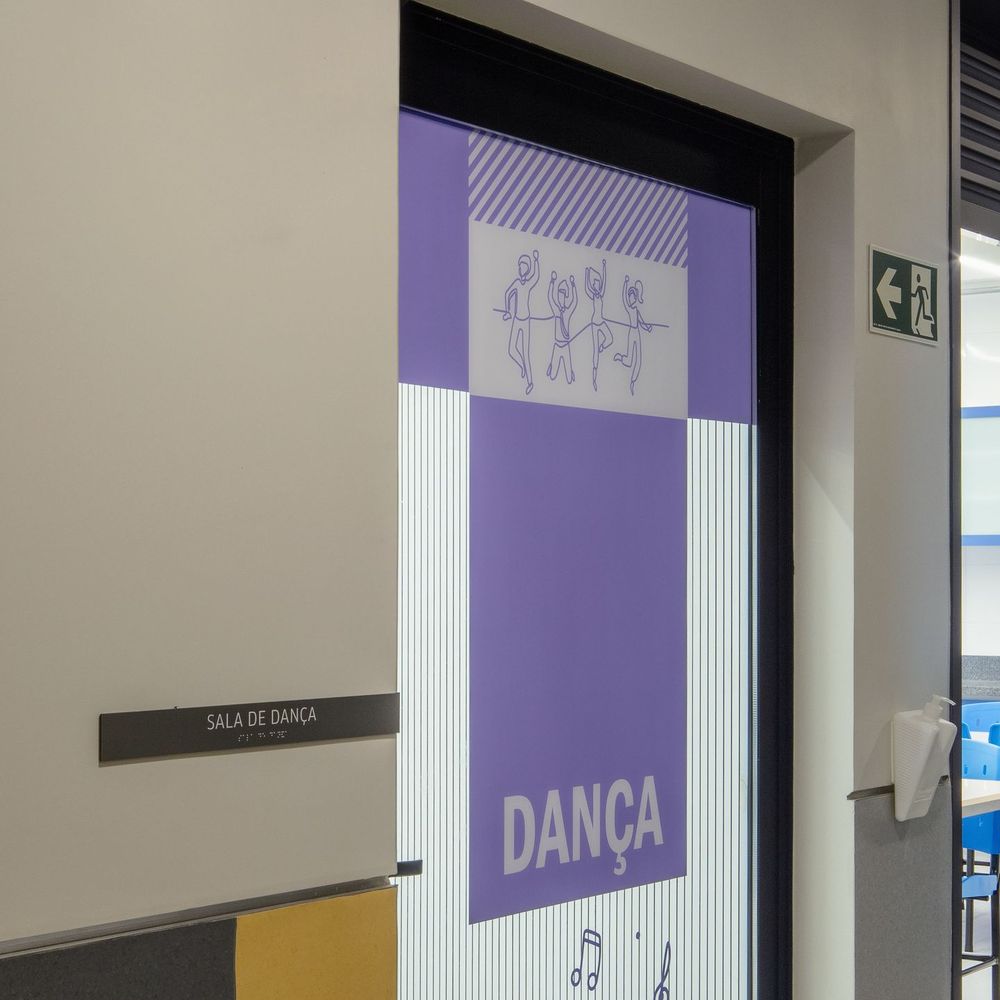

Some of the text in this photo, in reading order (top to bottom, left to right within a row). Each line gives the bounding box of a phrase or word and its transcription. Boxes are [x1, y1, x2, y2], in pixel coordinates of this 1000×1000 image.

[207, 706, 317, 731] SALA DE DANÇA
[503, 775, 664, 876] DANÇA
